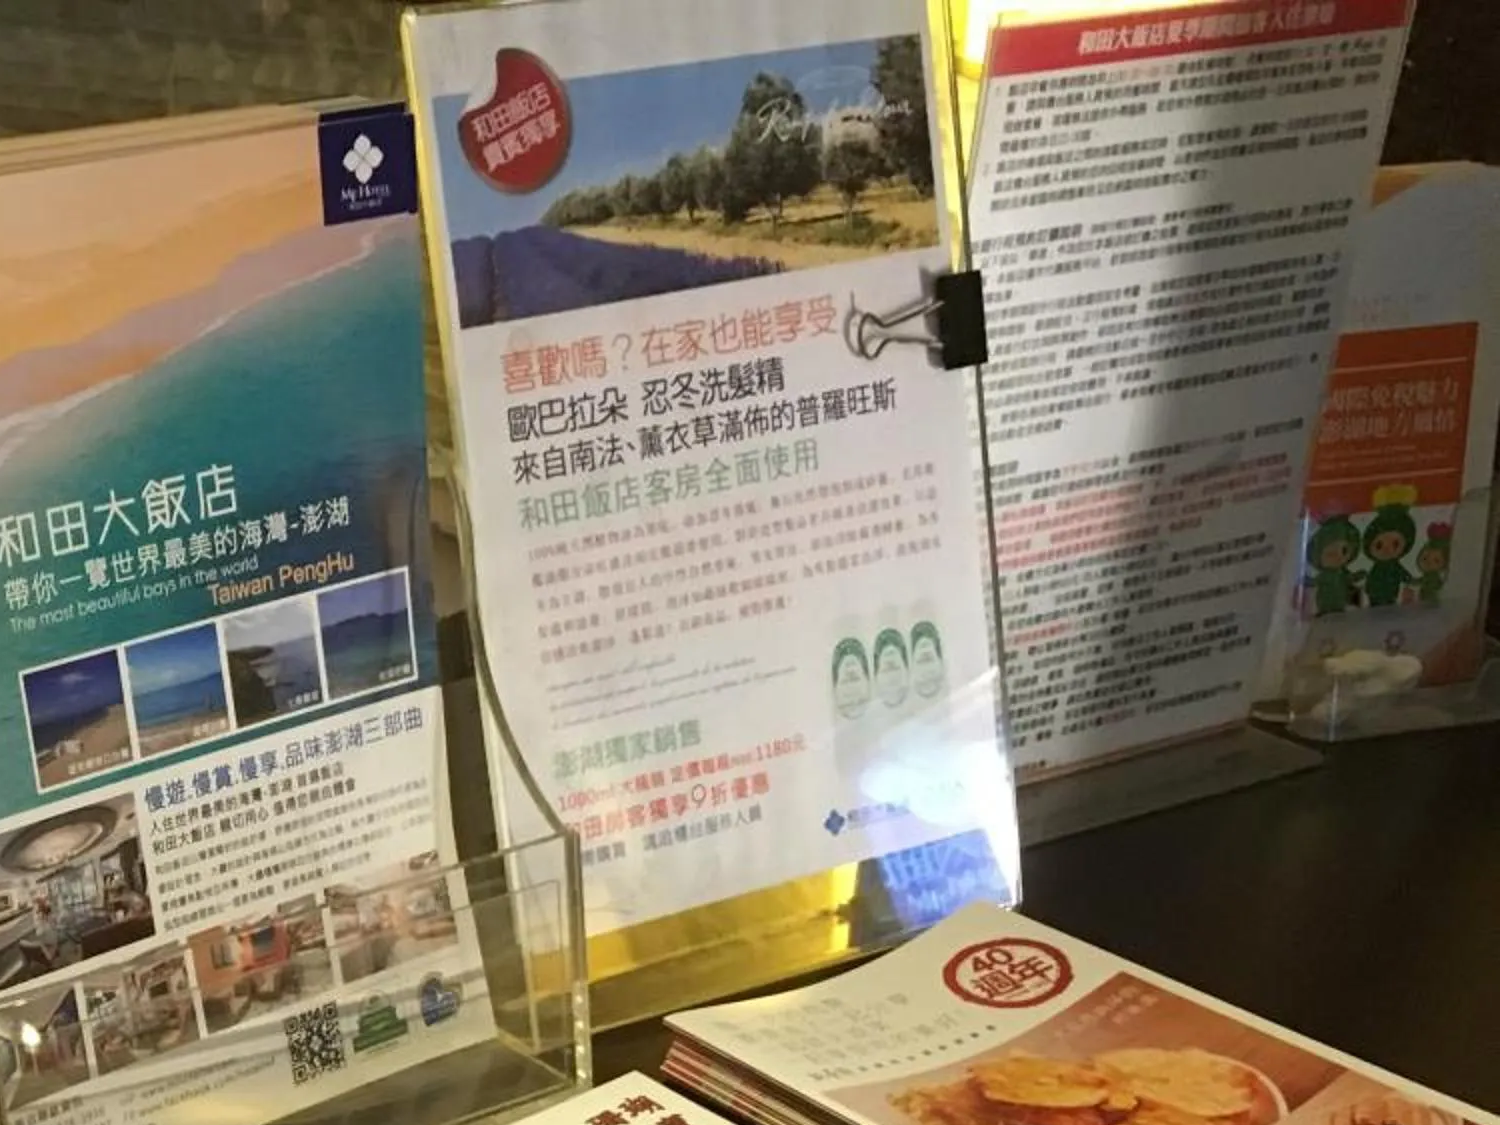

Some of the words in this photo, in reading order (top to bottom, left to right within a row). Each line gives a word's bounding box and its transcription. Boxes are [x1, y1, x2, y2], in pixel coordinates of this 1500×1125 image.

[502, 295, 837, 394] 喜歡嗎？在家也能享受
[508, 387, 628, 442] 歐巴拉朵
[642, 358, 784, 417] 忍冬洗髮精
[520, 439, 819, 531] 和田飯店客房全面使用
[3, 495, 350, 610] 帶你一覽世界最美的海灣-澎湖
[10, 615, 37, 634] The
[39, 605, 75, 626] most
[78, 586, 141, 618] beautiful
[143, 579, 178, 603] bays
[180, 574, 191, 590] in
[194, 567, 218, 585] the
[221, 555, 260, 578] world
[207, 575, 274, 607] Taiwan
[279, 552, 355, 589] PengHu
